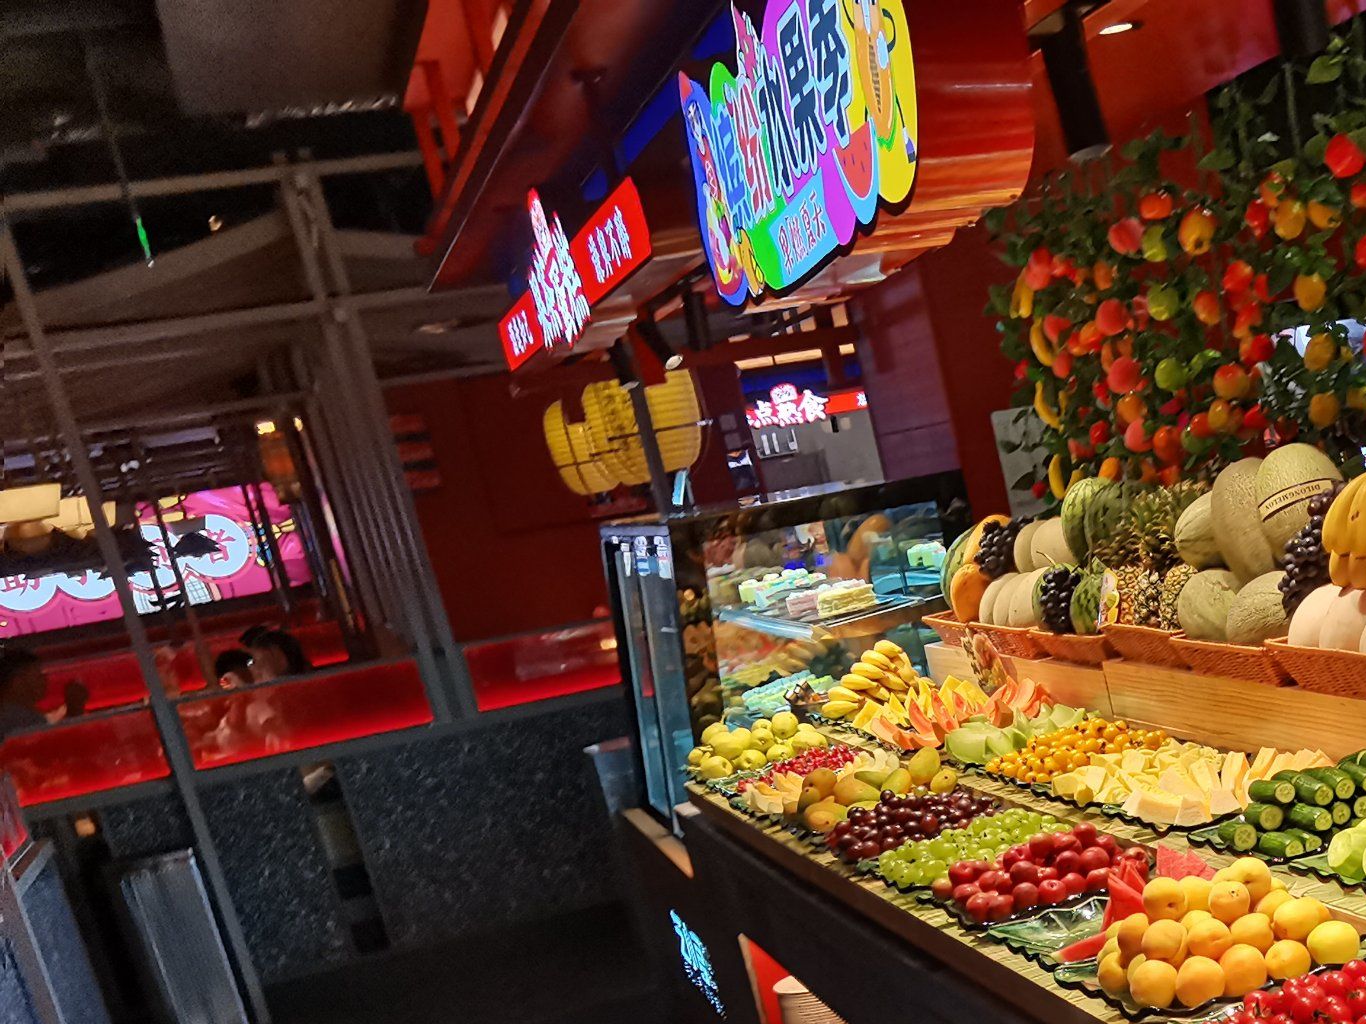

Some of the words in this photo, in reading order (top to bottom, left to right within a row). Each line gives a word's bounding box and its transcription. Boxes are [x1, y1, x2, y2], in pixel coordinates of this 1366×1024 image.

[711, 0, 852, 229] 缤纷水果季
